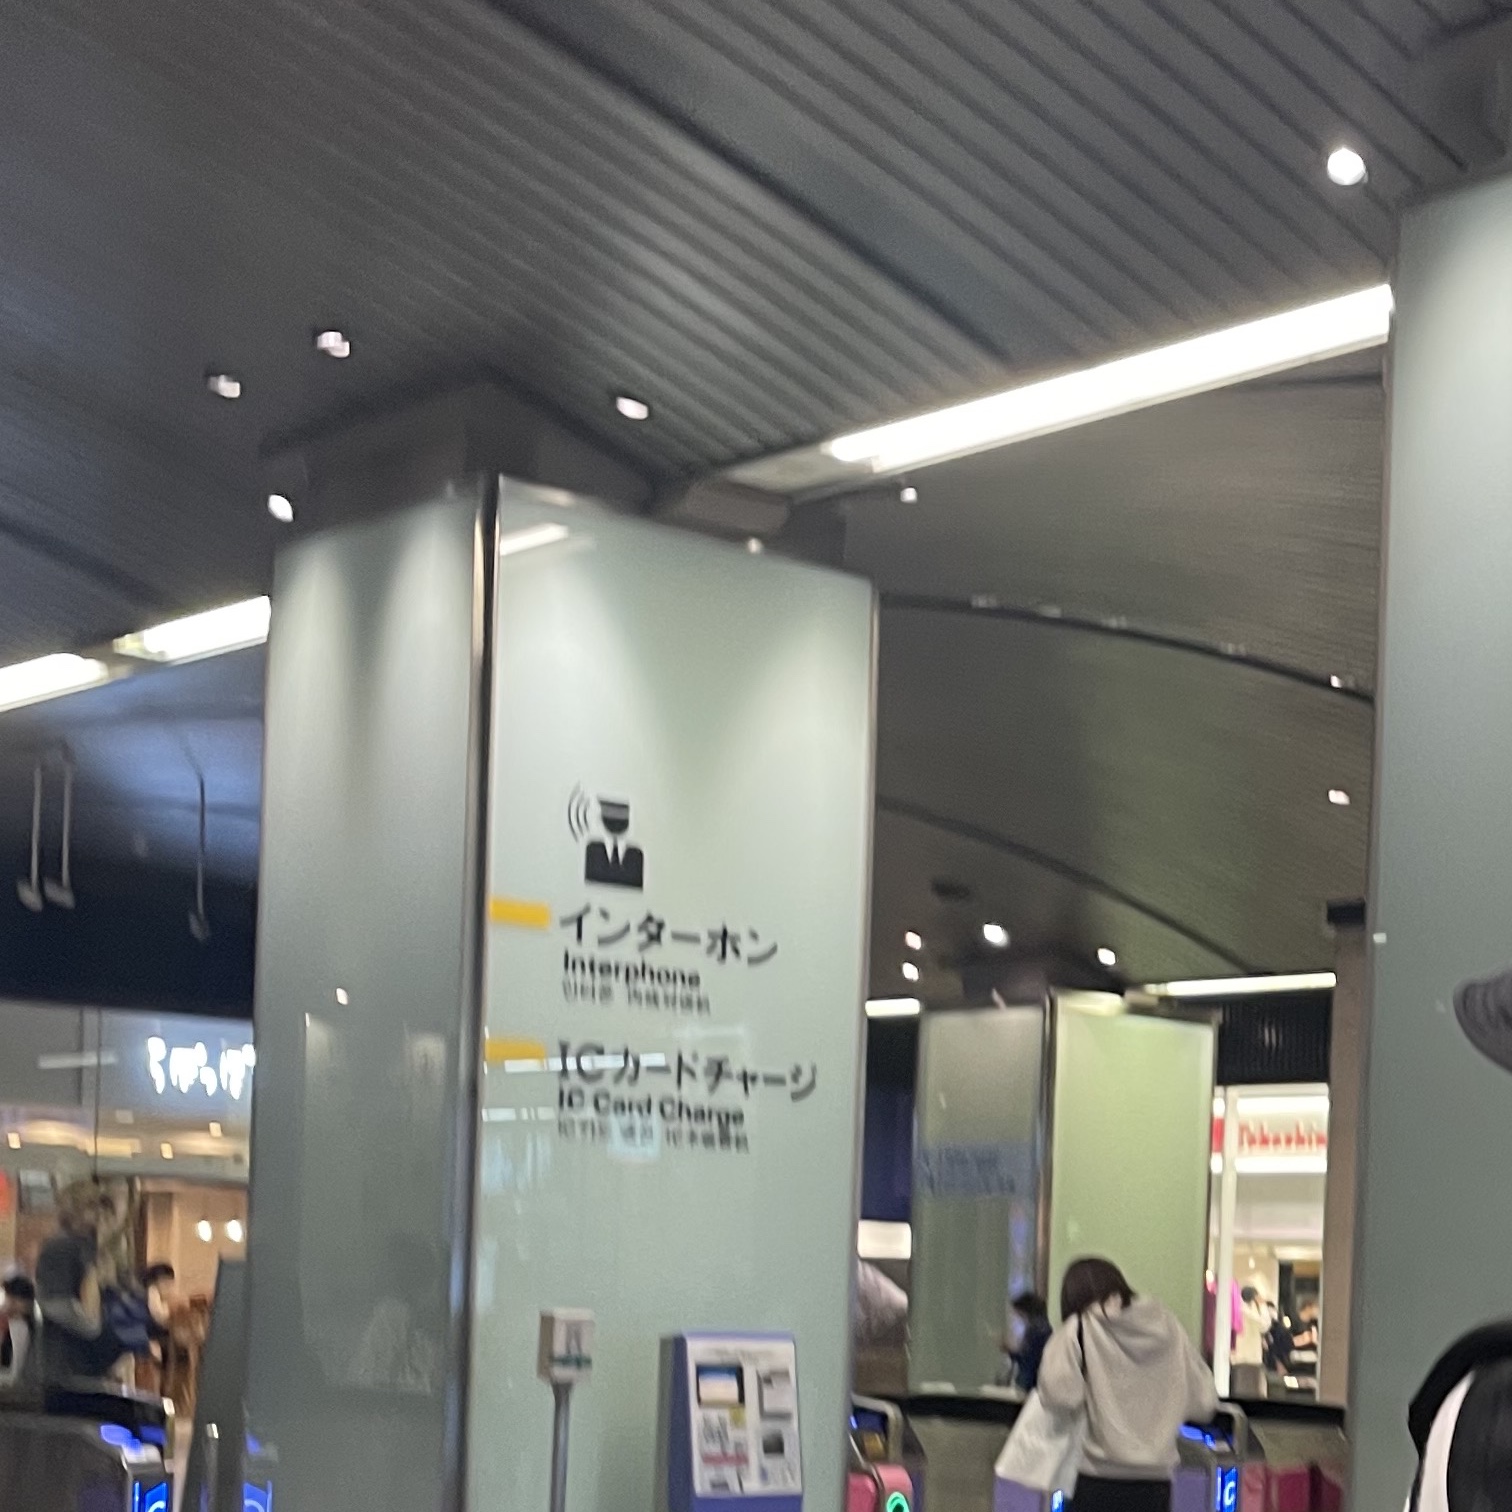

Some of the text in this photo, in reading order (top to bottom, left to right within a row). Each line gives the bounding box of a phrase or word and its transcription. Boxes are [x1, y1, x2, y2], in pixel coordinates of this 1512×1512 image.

[559, 902, 778, 966] インターホン
[564, 949, 701, 987] Interphone
[557, 1038, 817, 1102] ICカードチャージ
[558, 1084, 745, 1130] IC Card Charge
